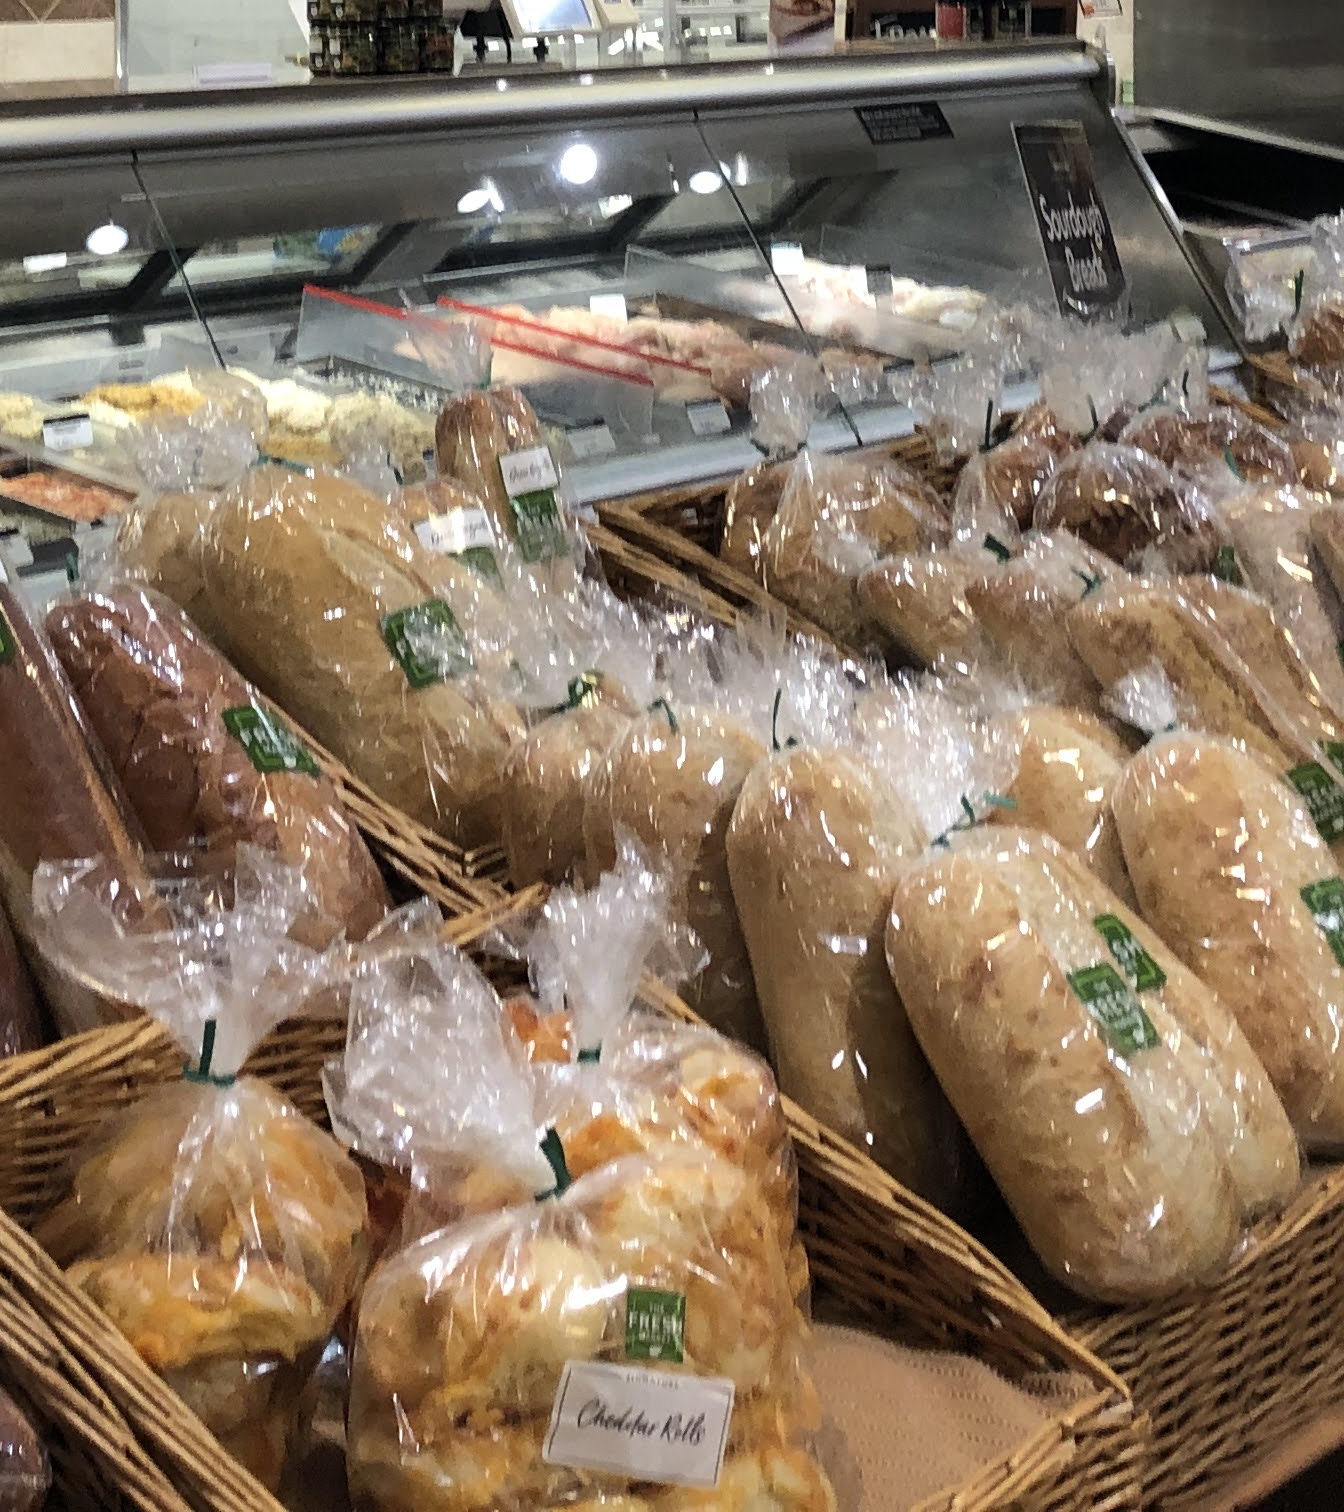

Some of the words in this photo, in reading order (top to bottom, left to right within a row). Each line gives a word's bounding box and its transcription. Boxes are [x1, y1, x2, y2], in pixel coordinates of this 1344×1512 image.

[1038, 188, 1106, 251] Sourdough
[1064, 238, 1109, 293] Breads
[577, 1392, 660, 1439] Cheddar
[660, 1410, 707, 1447] Rolls
